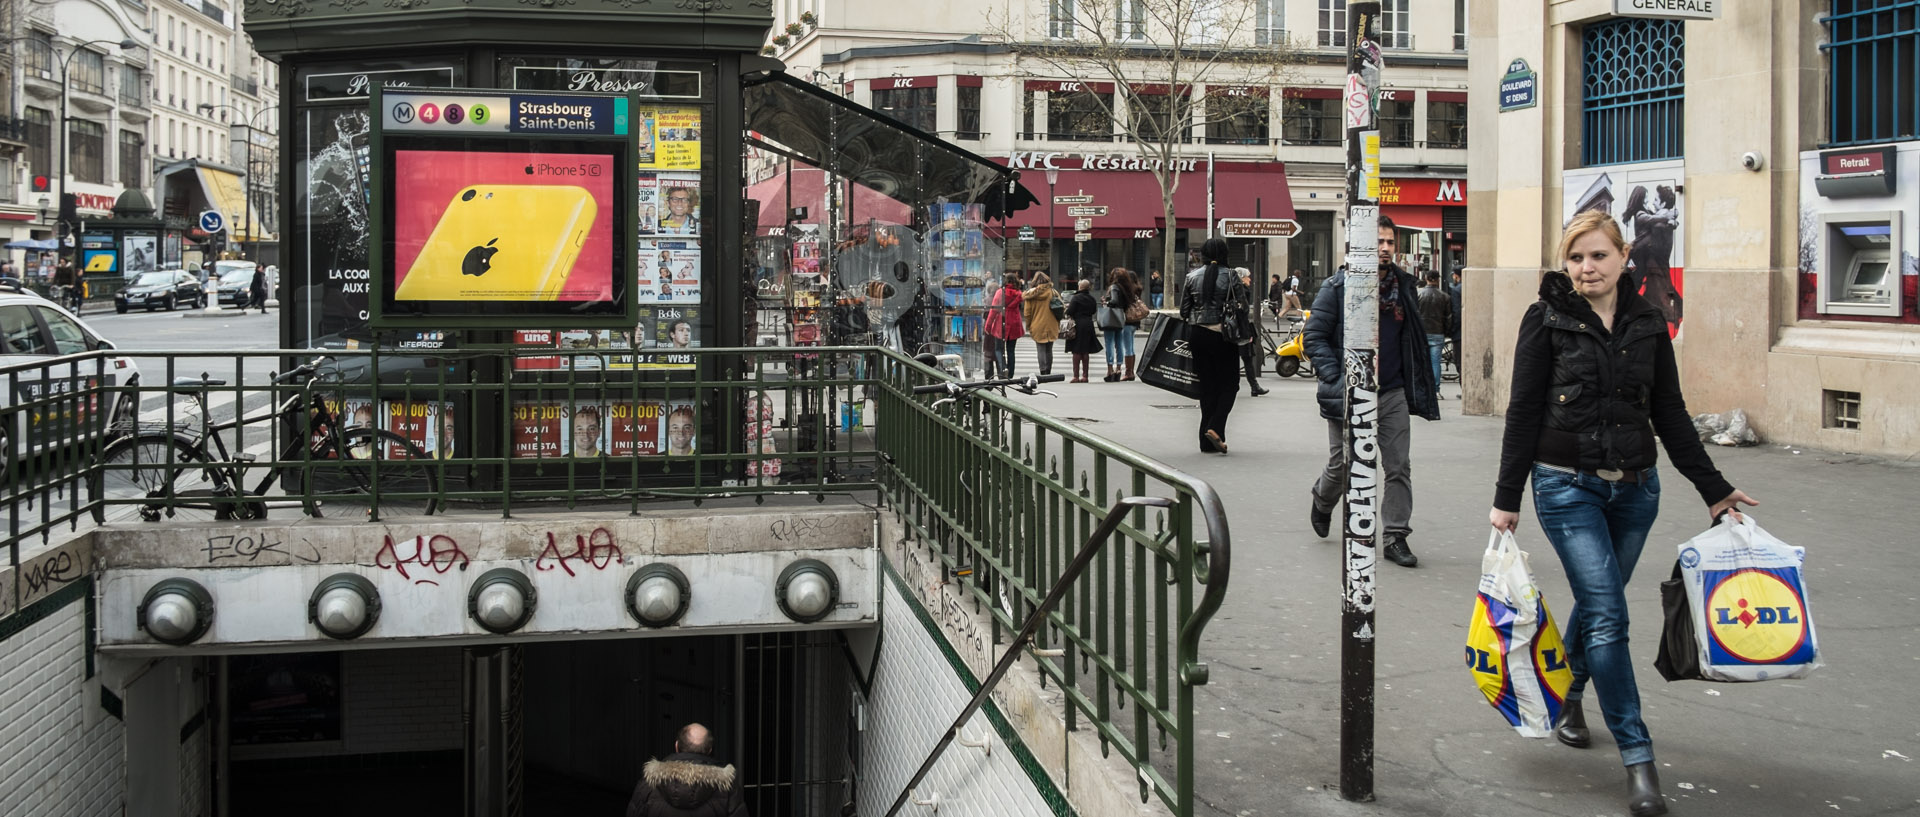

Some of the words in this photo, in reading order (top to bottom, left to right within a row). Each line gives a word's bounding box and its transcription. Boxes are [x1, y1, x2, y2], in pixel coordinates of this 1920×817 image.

[347, 74, 410, 95] Psse
[567, 70, 648, 92] Presse
[893, 78, 914, 88] KFC
[1059, 82, 1082, 92] KFC
[1501, 80, 1532, 92] BOULEVARD
[1228, 87, 1248, 96] KFC
[1512, 92, 1528, 102] DENIS
[397, 107, 410, 119] M
[423, 107, 434, 120] 4
[449, 107, 458, 121] 8
[475, 106, 485, 121] 9
[519, 102, 592, 118] Strasbourg
[519, 117, 595, 130] Saint-Denis
[1007, 151, 1061, 169] KFC
[1840, 157, 1870, 168] Retrait
[537, 163, 577, 176] iPhone
[579, 163, 587, 176] 5
[1436, 180, 1463, 201] M
[1381, 195, 1399, 203] TER
[768, 227, 785, 236] KFC
[1134, 229, 1153, 239] KFC
[329, 269, 342, 279] LA
[342, 283, 365, 293] AUX
[524, 333, 549, 342] une
[667, 354, 690, 363] WEB
[391, 404, 401, 416] SO
[513, 406, 527, 420] SO
[612, 405, 626, 418] SO
[1541, 648, 1567, 673] L
